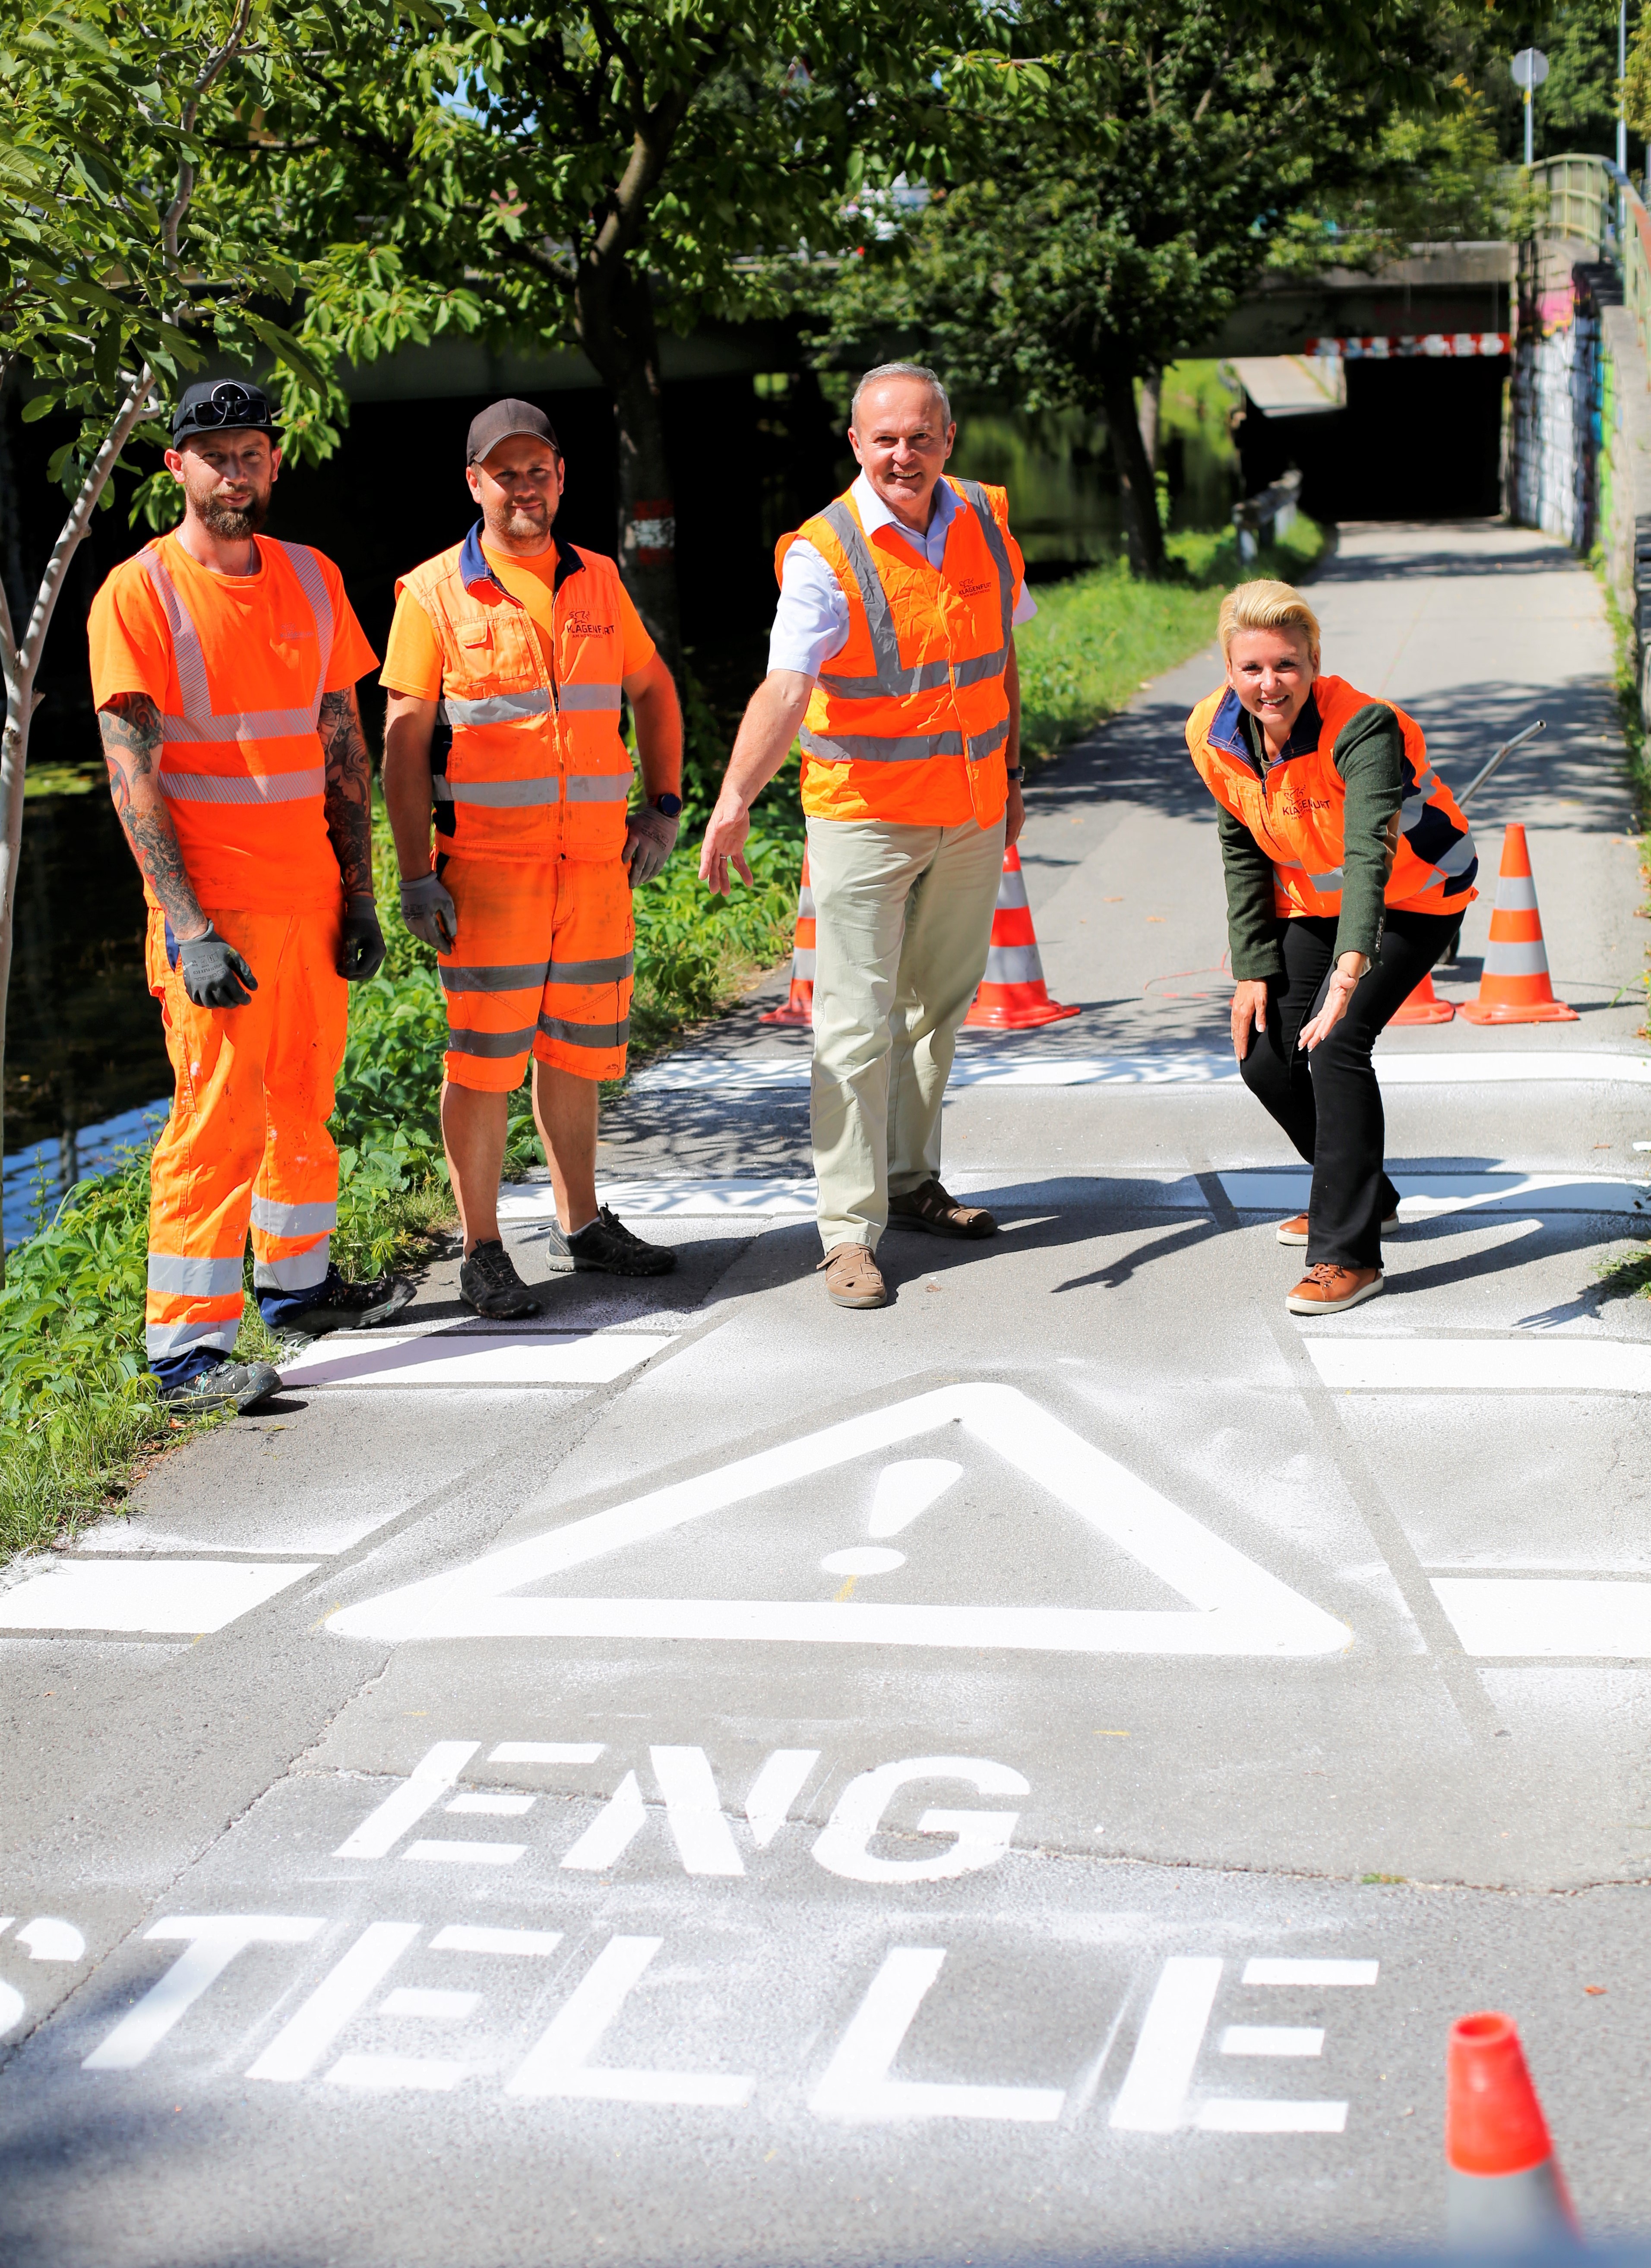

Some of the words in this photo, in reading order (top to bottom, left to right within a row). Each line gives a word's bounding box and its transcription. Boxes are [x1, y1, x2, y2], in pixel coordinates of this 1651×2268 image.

[566, 624, 614, 635] KLAGENFRT
[1282, 799, 1330, 816] KLAGENURT
[332, 1740, 1030, 1884] ENG
